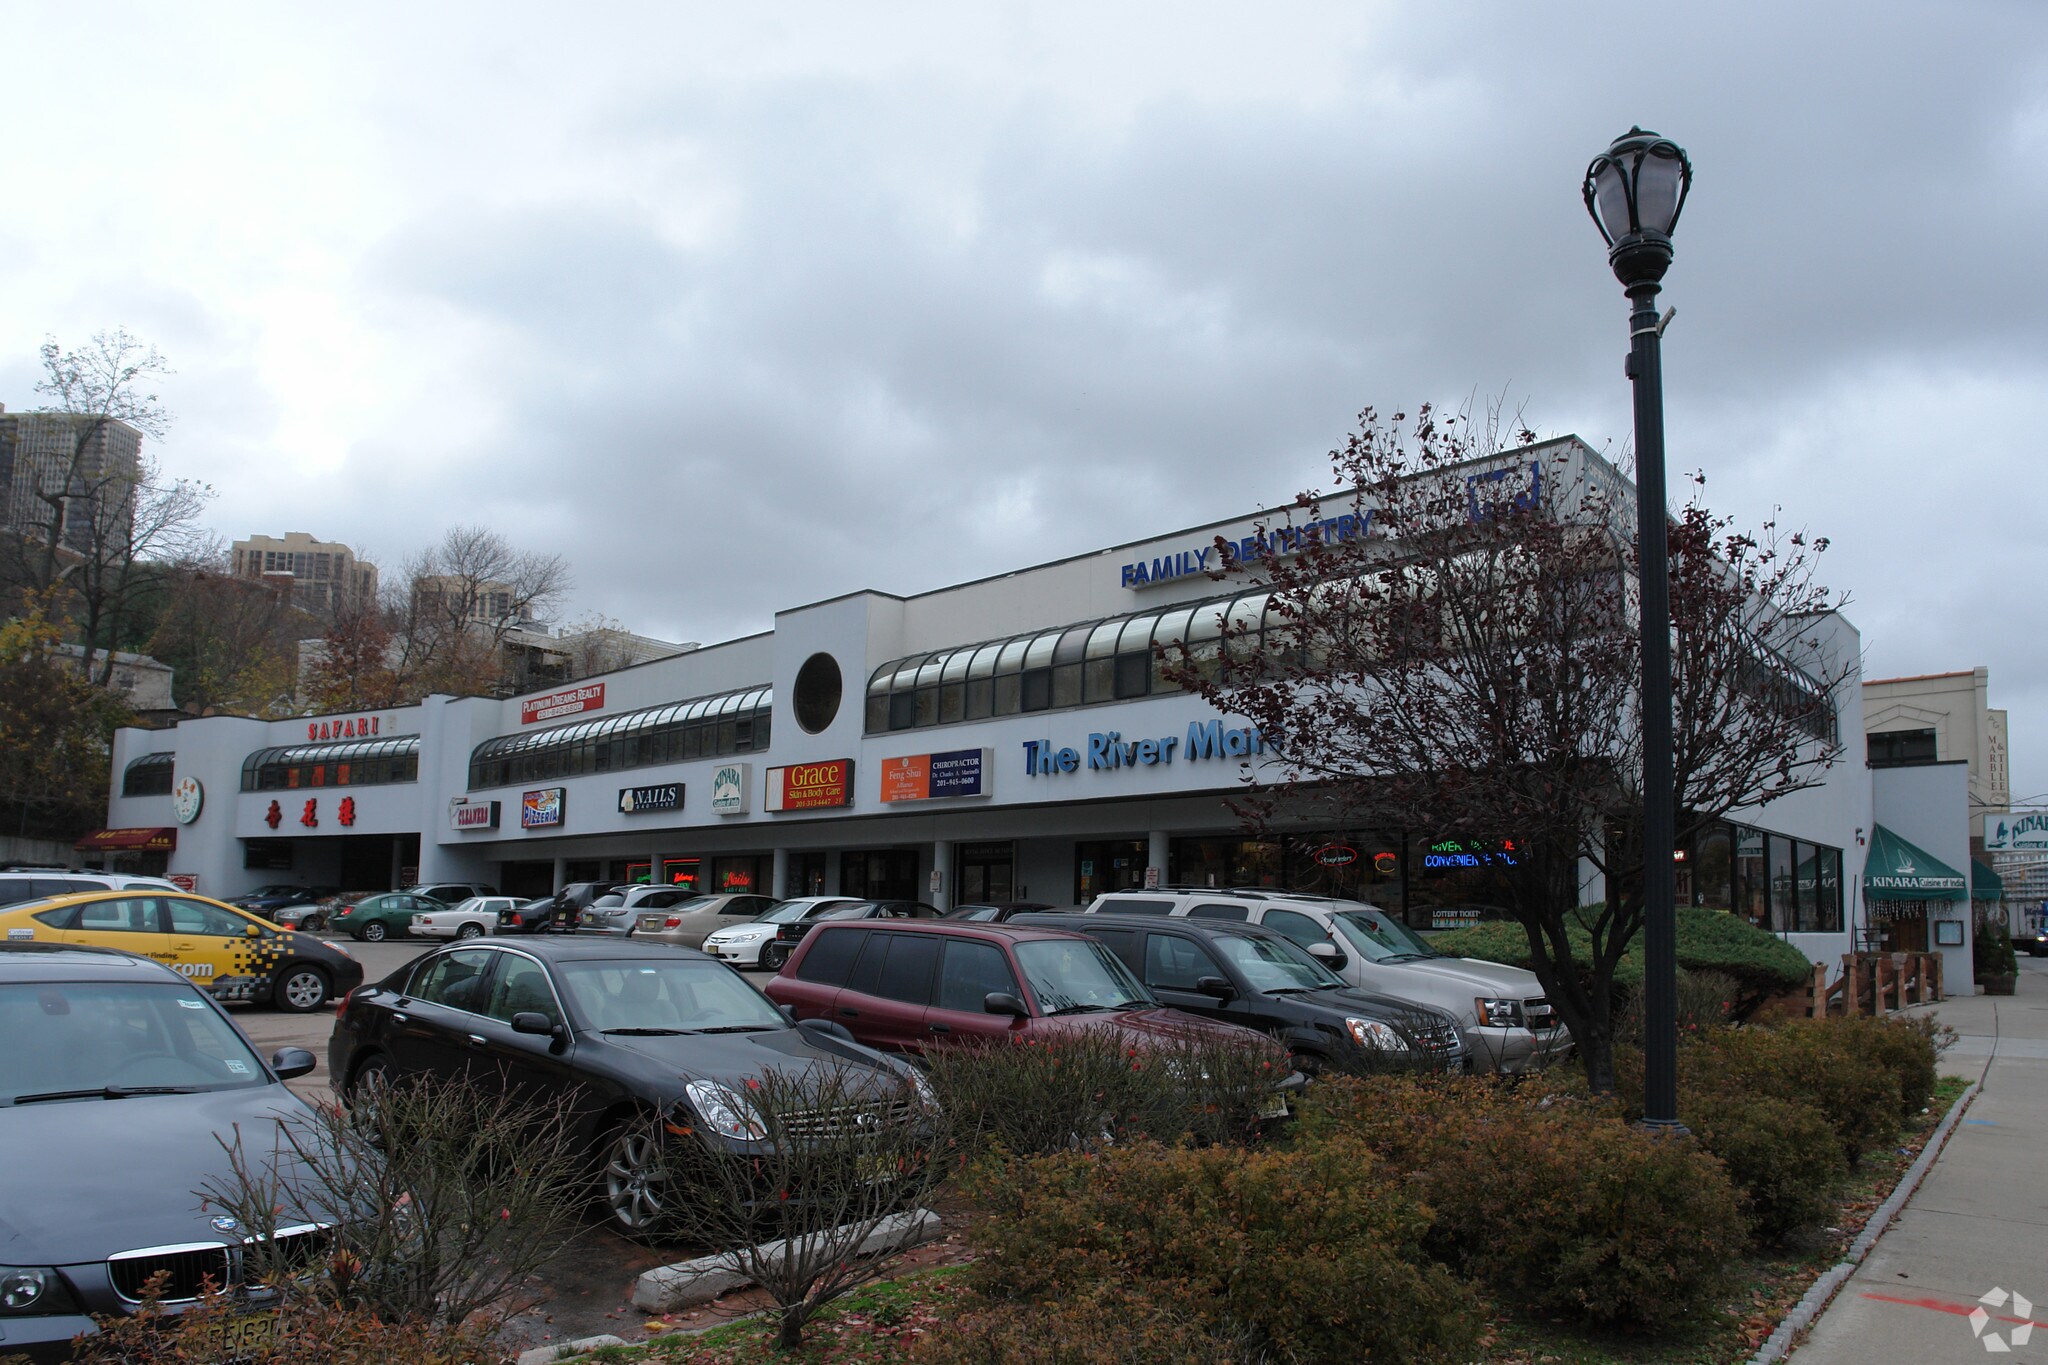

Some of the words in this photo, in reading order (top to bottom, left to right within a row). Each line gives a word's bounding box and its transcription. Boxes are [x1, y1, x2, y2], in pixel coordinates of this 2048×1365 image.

[1121, 546, 1209, 588] FAMILY
[1228, 509, 1374, 562] DENTISTRY
[523, 697, 551, 713] PLATINUM
[552, 692, 577, 706] DREAMS
[577, 686, 601, 701] REALTY
[538, 703, 582, 718] 201-840-6800
[308, 716, 379, 741] SAFARI
[1022, 739, 1081, 777] The
[1088, 731, 1178, 771] River
[1184, 719, 1284, 761] Mar
[1997, 743, 2005, 751] &
[932, 758, 980, 770] CHIROPRACTOR
[1988, 735, 1998, 791] MARBLE
[714, 768, 740, 798] KINARA
[791, 765, 839, 787] Grace
[889, 771, 905, 781] Feng
[906, 768, 921, 778] Shui
[937, 777, 975, 787] 201-945-0600
[635, 786, 676, 804] NAILS
[789, 790, 802, 799] Skin
[807, 788, 824, 798] Body
[825, 787, 841, 796] Care
[524, 806, 558, 824] PIZZERIA
[1873, 876, 1919, 888] KINARA
[1920, 878, 1942, 887] Cuisine
[1942, 877, 1949, 887] of
[1950, 877, 1965, 887] India
[1432, 910, 1458, 918] LOTTERY
